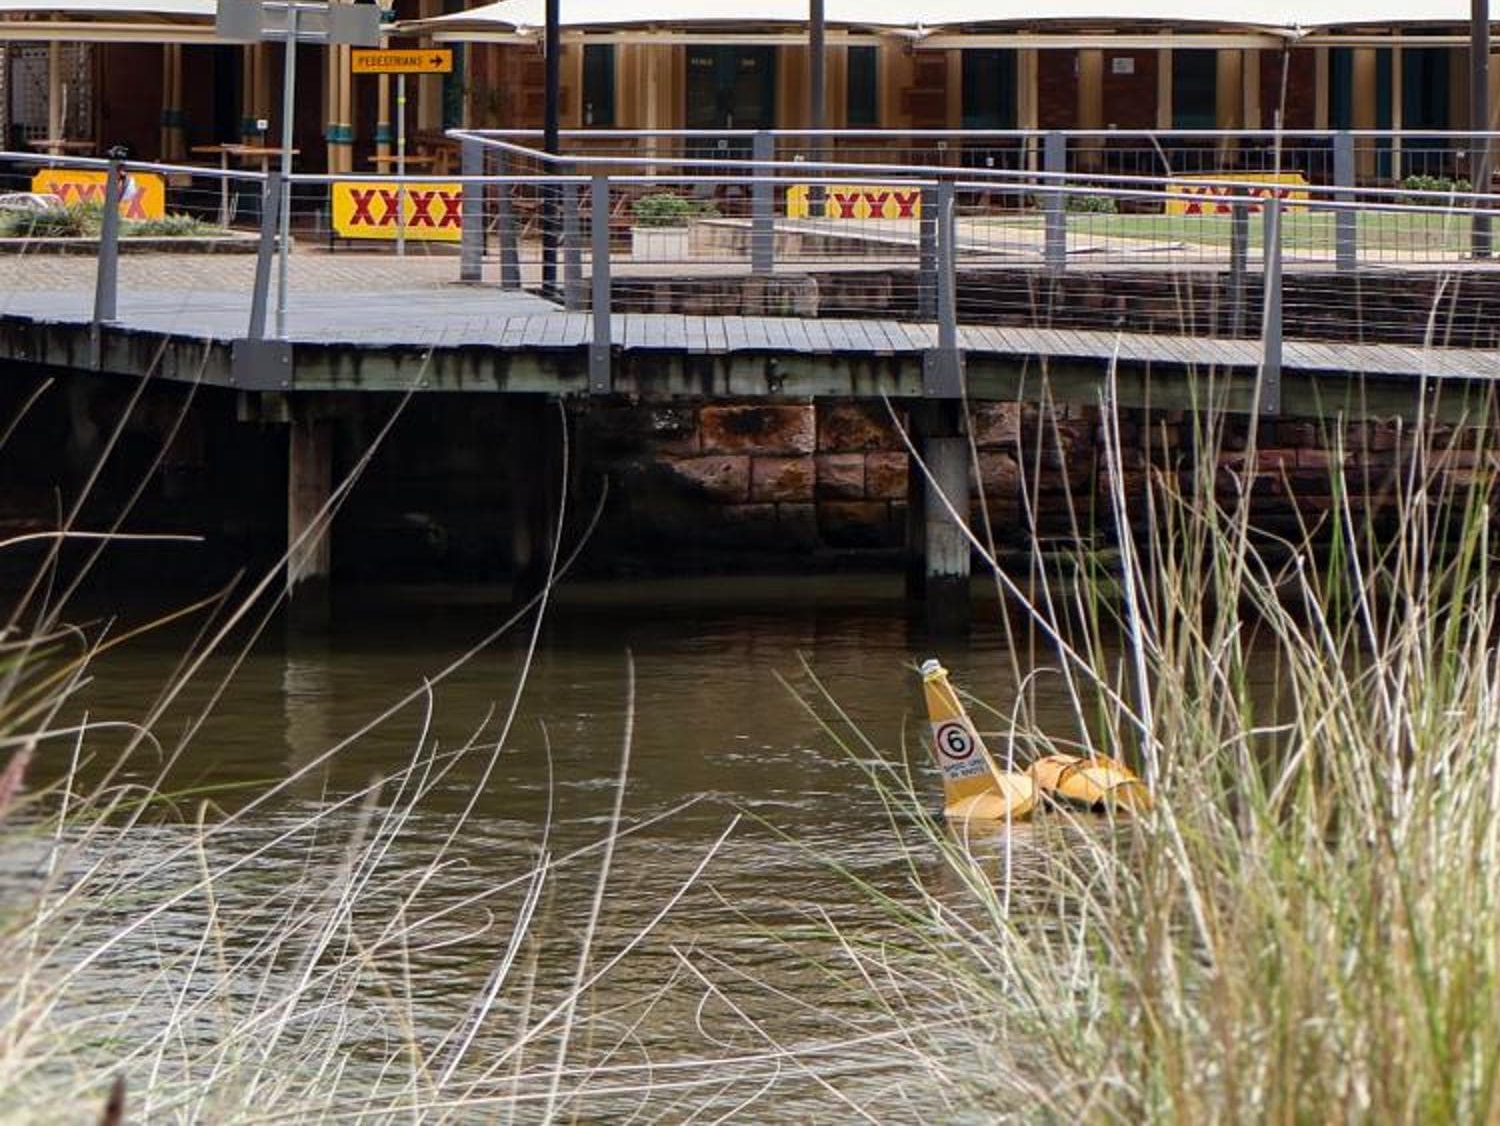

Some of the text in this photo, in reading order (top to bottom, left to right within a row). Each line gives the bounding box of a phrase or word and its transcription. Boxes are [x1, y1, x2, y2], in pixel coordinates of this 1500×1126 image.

[349, 189, 462, 227] XXXX
[804, 191, 920, 218] XXX
[947, 730, 966, 753] 6
